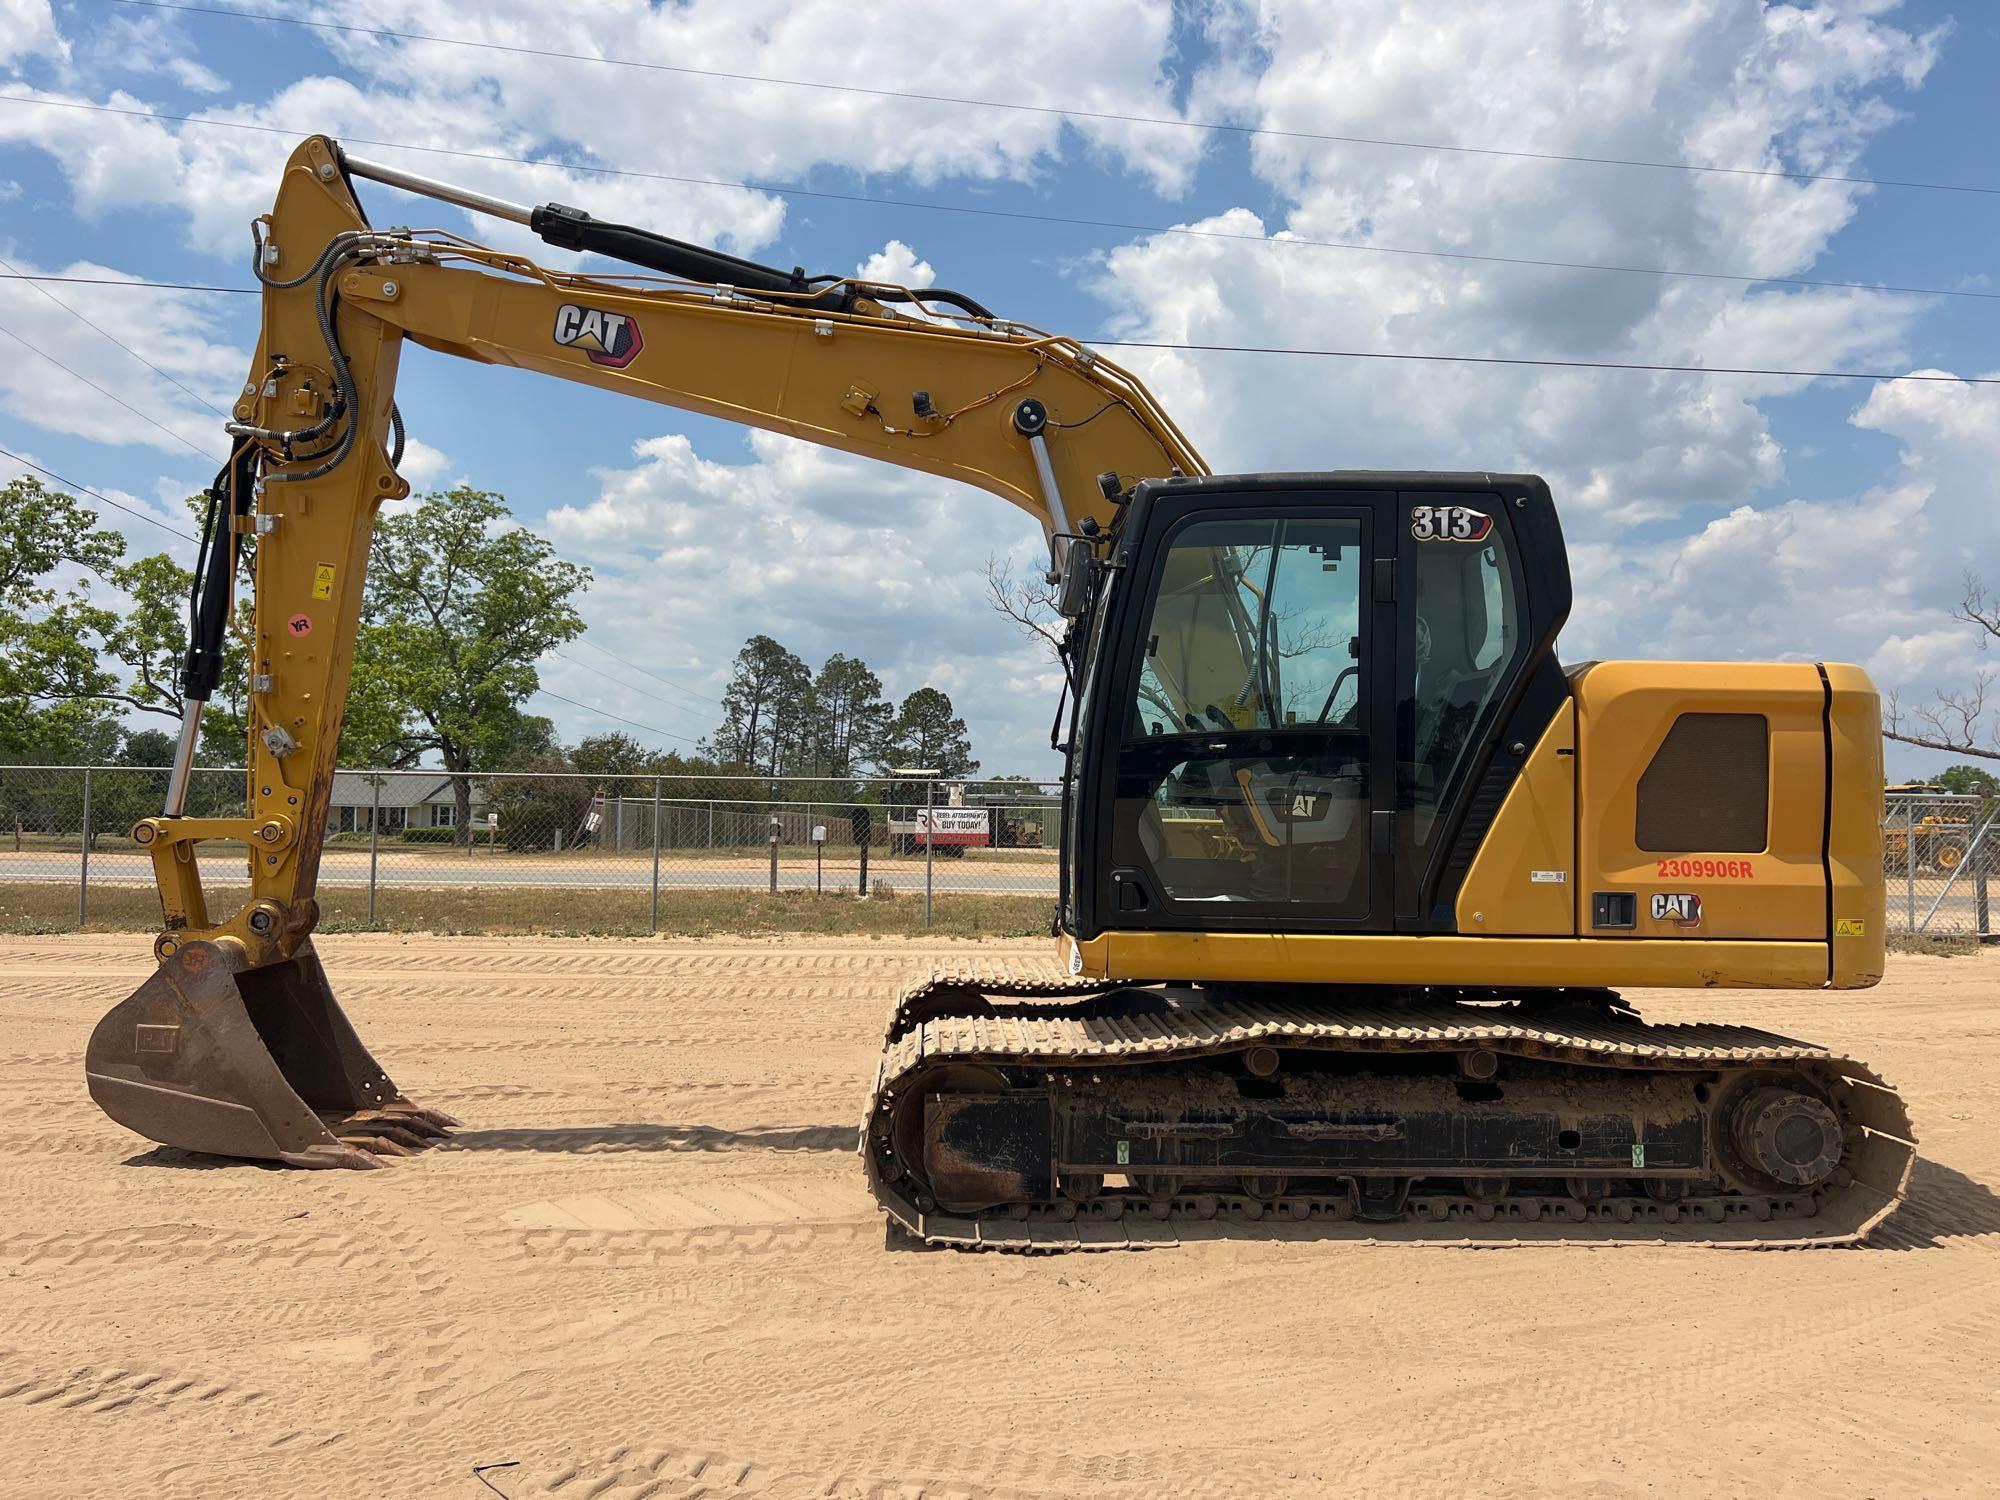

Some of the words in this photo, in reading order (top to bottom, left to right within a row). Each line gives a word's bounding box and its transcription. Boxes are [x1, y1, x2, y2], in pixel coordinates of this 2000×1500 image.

[554, 304, 626, 355] CAT
[1414, 507, 1472, 539] 313
[941, 820, 956, 830] BUY
[957, 820, 981, 830] TODAY!
[1656, 859, 1754, 879] 2309906R
[1651, 894, 1692, 920] CAT
